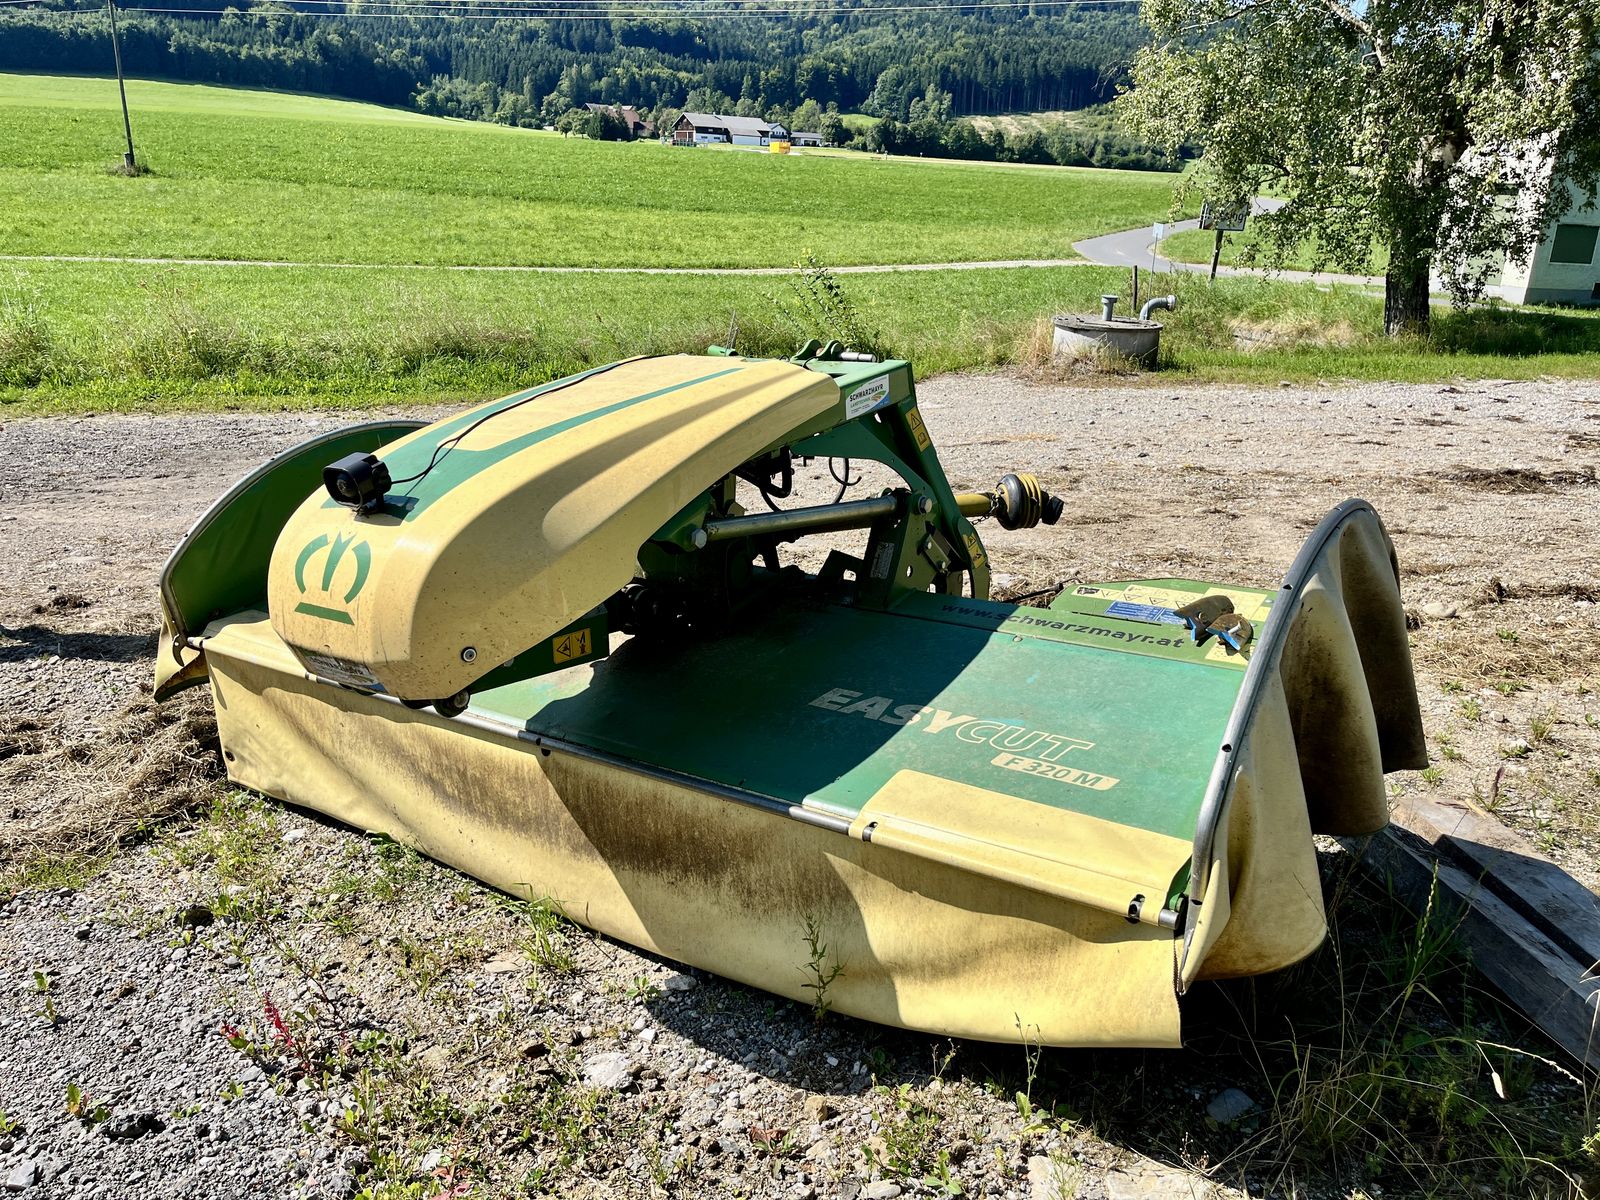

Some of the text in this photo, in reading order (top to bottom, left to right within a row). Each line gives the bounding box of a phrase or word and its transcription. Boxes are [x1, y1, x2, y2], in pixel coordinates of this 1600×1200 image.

[942, 605, 1184, 648] www.schwarzmayr.at
[1003, 757, 1103, 787] F 320 M
